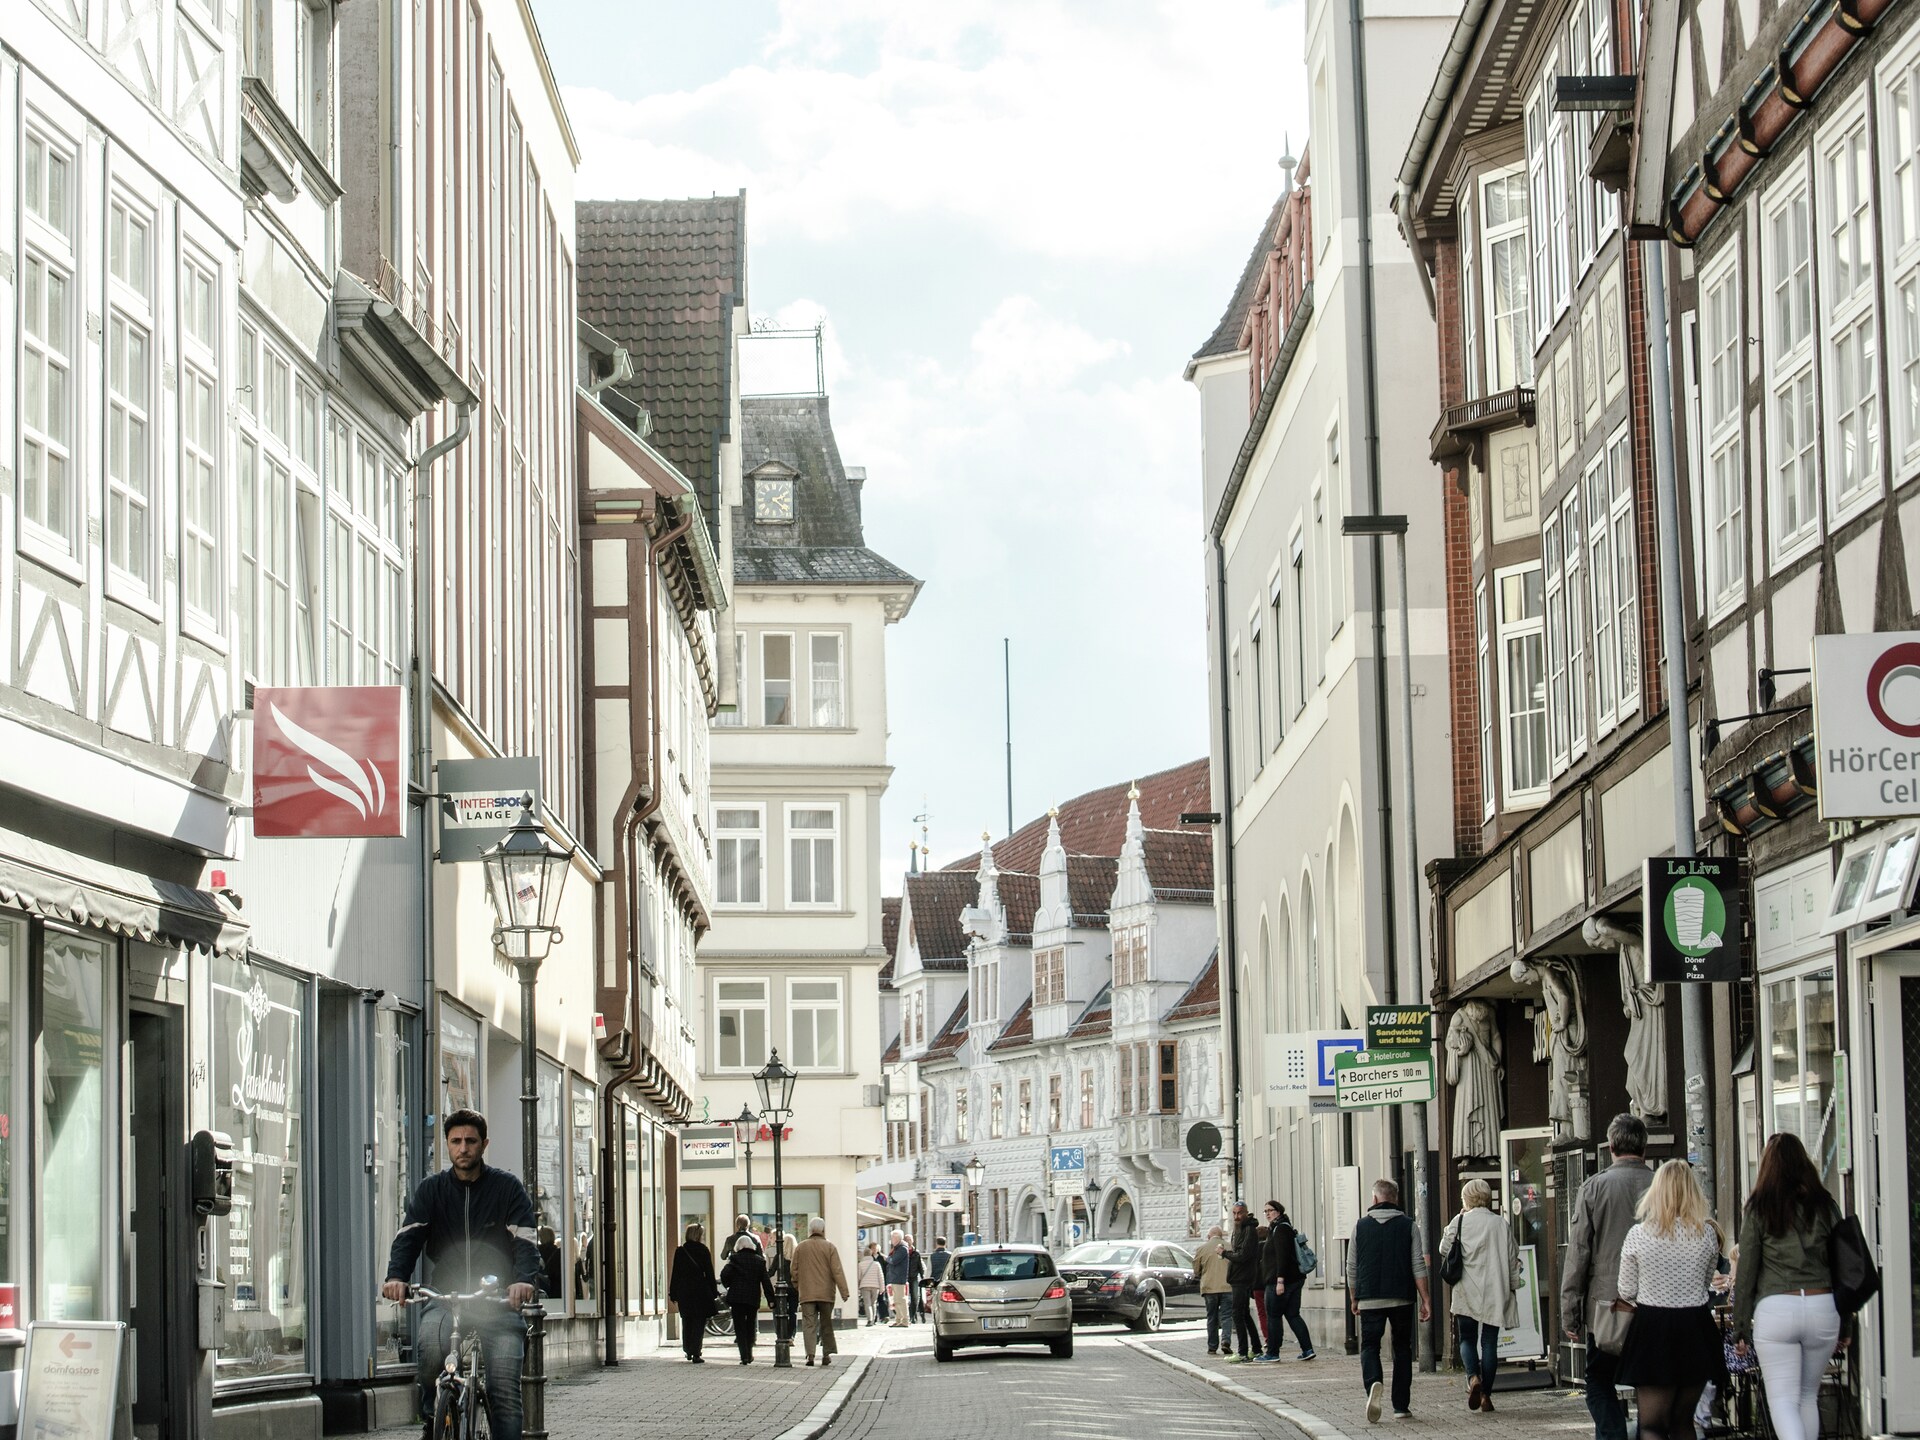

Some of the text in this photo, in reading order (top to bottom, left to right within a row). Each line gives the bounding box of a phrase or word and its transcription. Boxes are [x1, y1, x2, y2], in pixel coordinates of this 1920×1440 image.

[460, 797, 522, 809] INTERSPO
[466, 810, 512, 820] LANGE
[1667, 860, 1720, 875] La Liva
[1684, 956, 1706, 964] Döner
[1369, 1011, 1430, 1026] SUBWAY
[1396, 1036, 1421, 1044] Salate
[1374, 1051, 1411, 1061] Hotelroute
[231, 1020, 286, 1115] Lederklinik
[1350, 1069, 1399, 1083] Borchers
[1403, 1068, 1414, 1077] 100
[1351, 1087, 1403, 1102] Celler Hof
